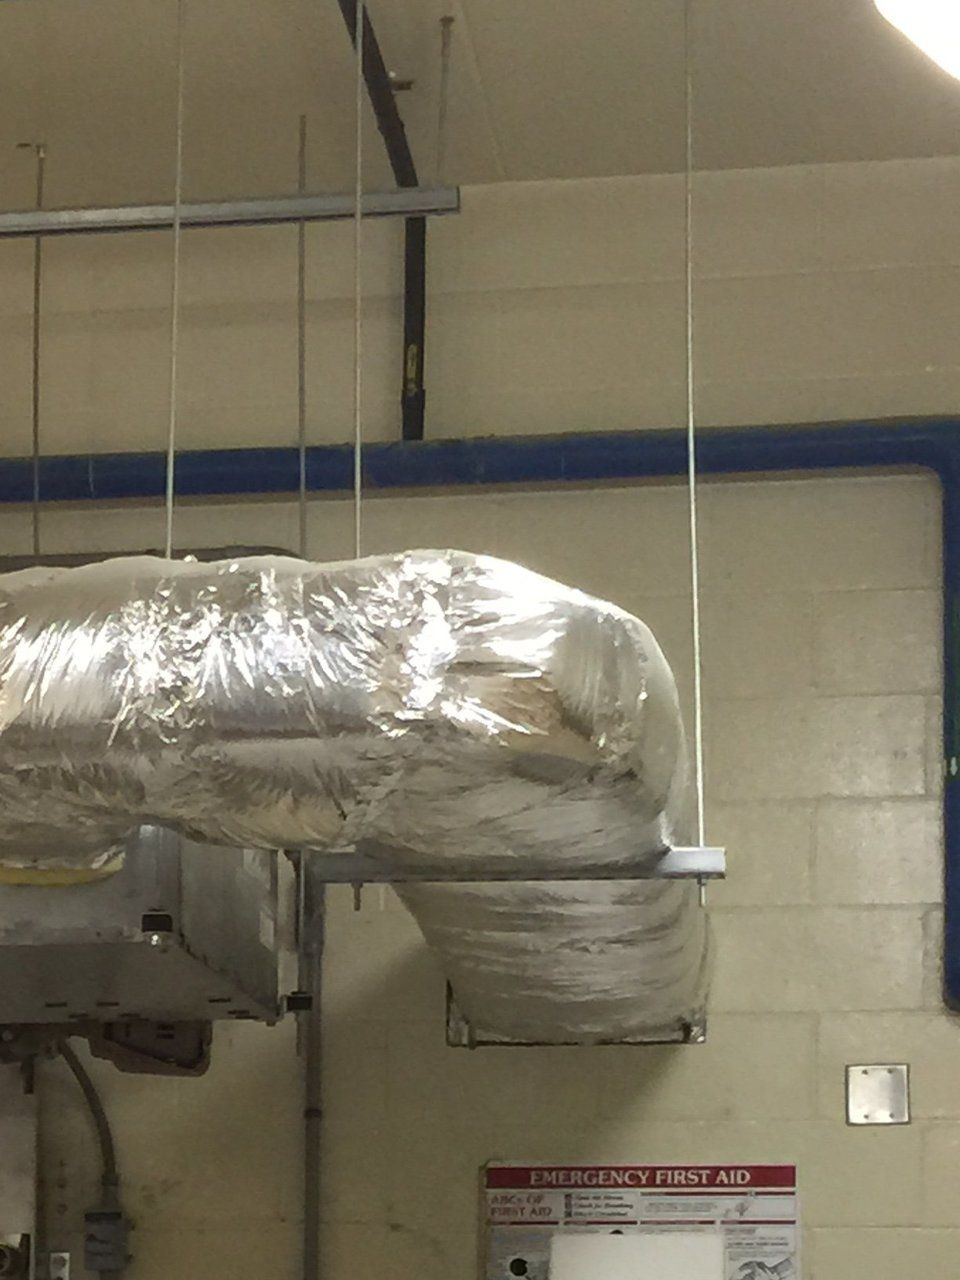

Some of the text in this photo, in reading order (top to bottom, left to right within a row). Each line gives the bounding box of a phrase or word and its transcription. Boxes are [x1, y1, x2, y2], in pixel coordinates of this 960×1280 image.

[529, 1170, 751, 1185] EMERGENCY FIRST AID
